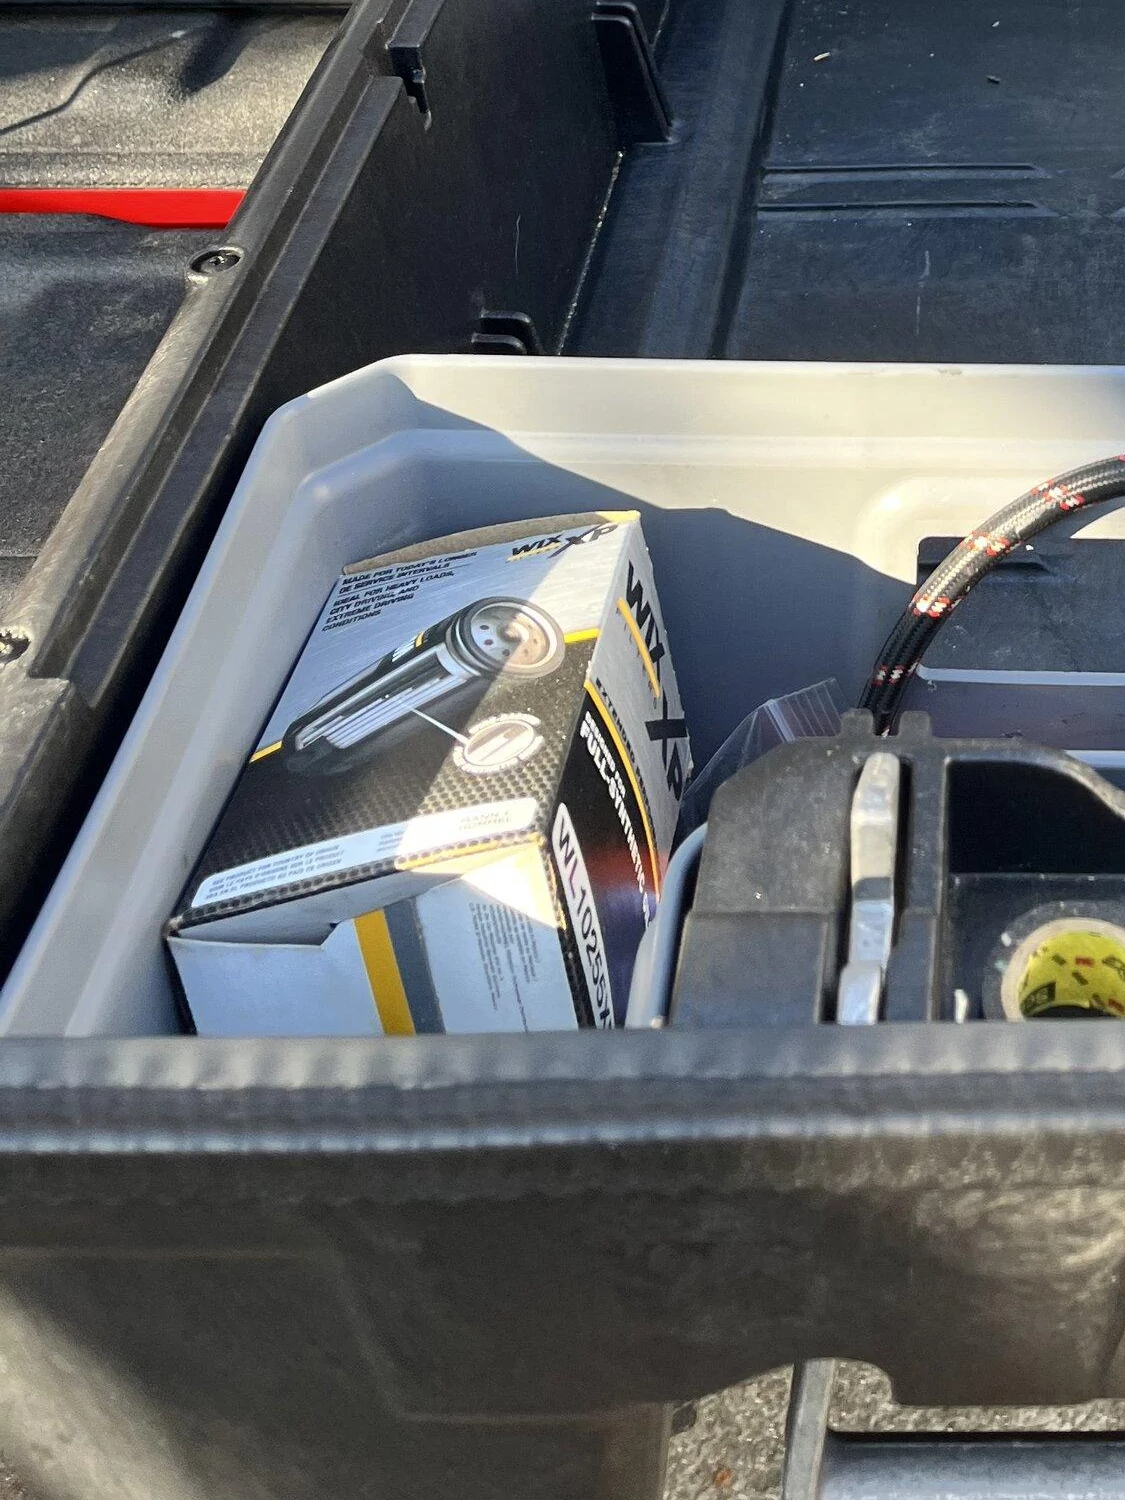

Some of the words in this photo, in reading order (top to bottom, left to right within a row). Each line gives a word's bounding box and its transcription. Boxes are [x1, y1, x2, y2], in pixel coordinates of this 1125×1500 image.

[512, 533, 563, 557] WIX
[548, 522, 619, 559] XP
[342, 573, 371, 586] MADE
[373, 567, 393, 578] FOR
[396, 559, 437, 573] TODAY'S
[438, 550, 478, 564] LONGER
[353, 576, 396, 590] SERVICE
[398, 562, 450, 579] INTERVALS
[330, 603, 354, 615] CITY
[398, 585, 419, 595] AND
[333, 594, 361, 607] IDEAL
[363, 587, 384, 598] FOR
[385, 579, 418, 593] HEAVY
[321, 609, 382, 632] CONDITIONS
[325, 606, 373, 624] EXTREME
[374, 593, 415, 609] DRIVING
[625, 560, 665, 682] WIX
[645, 688, 688, 802] XP
